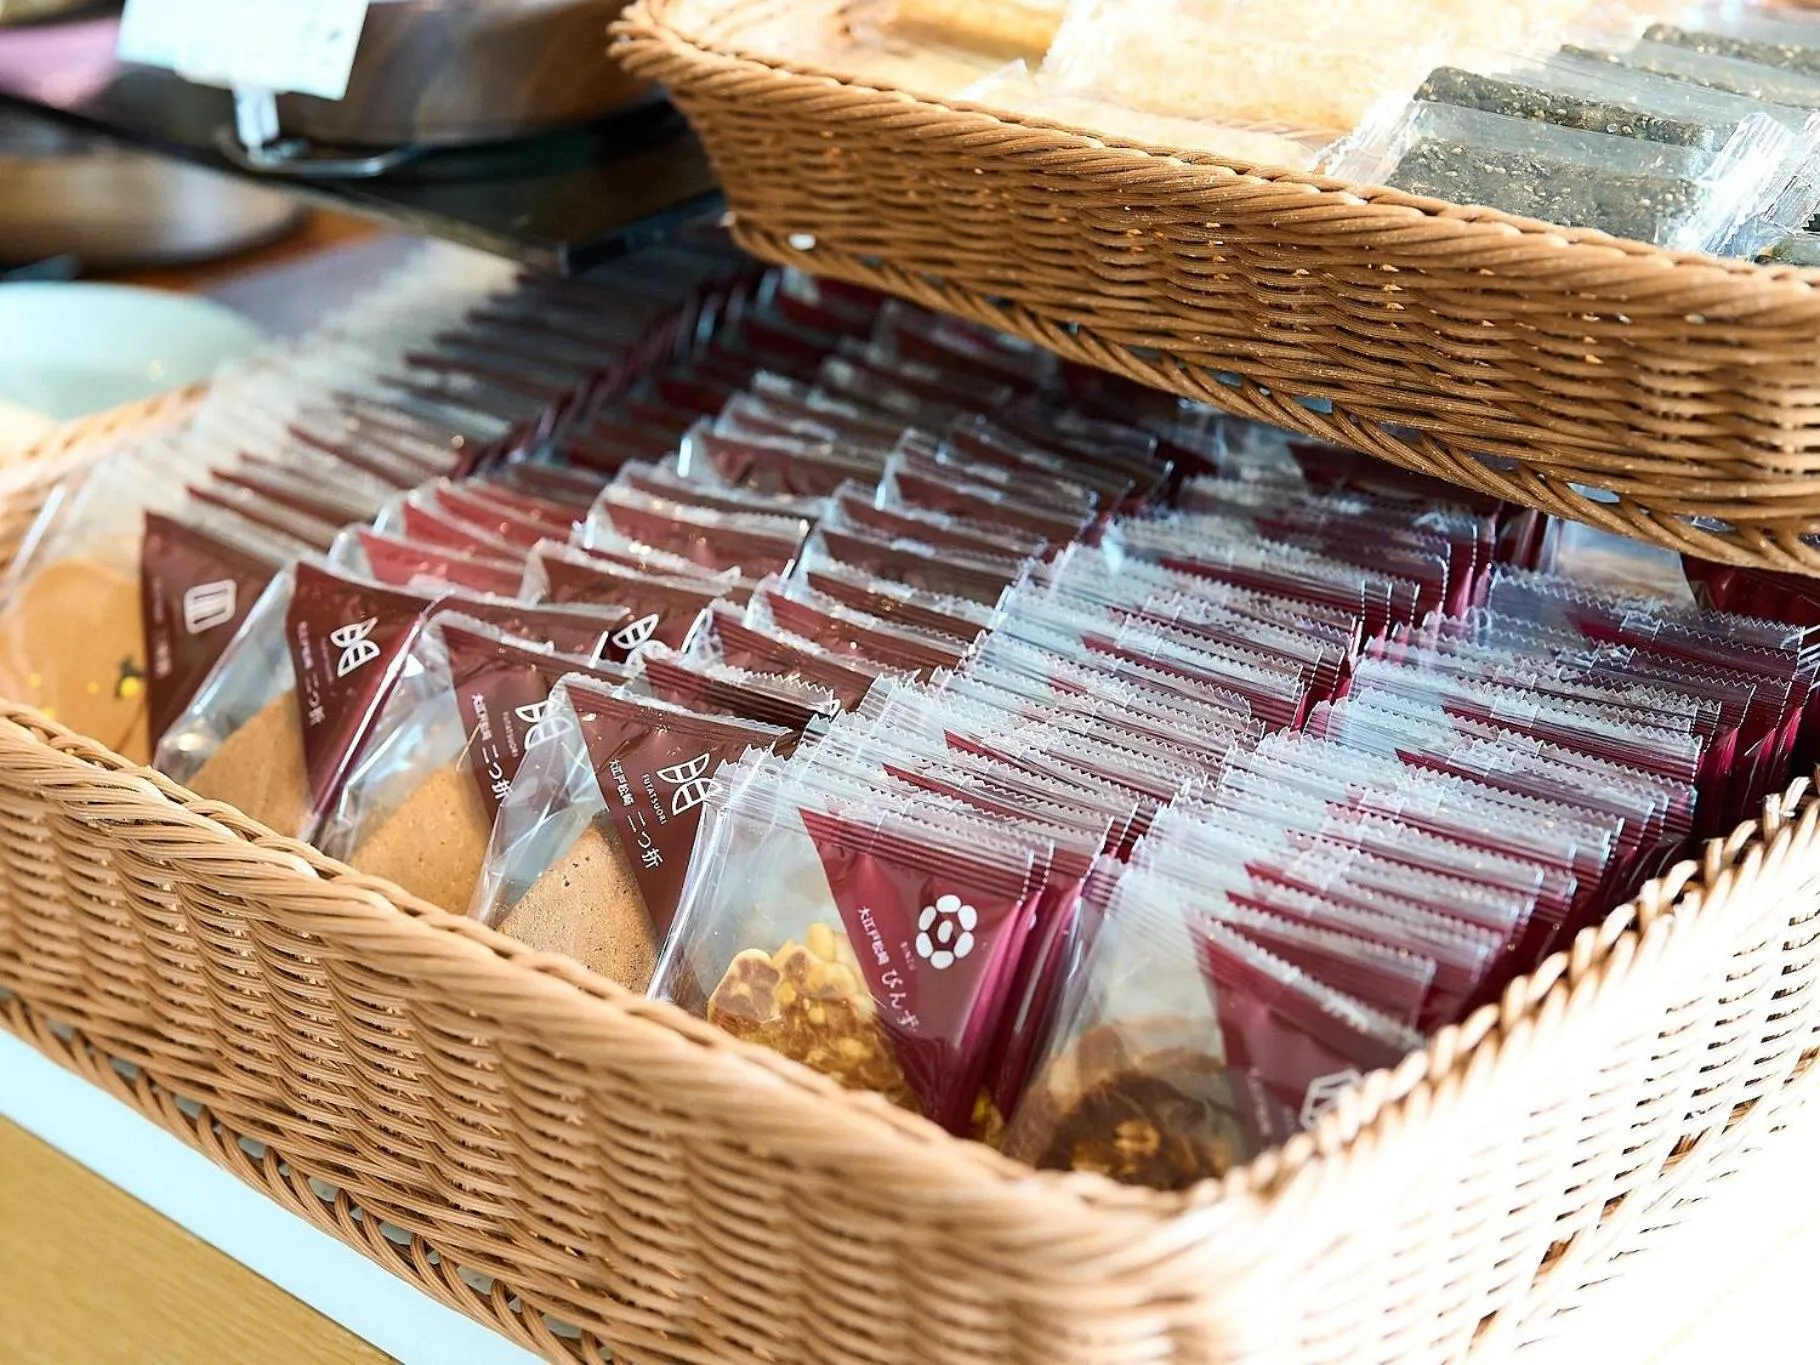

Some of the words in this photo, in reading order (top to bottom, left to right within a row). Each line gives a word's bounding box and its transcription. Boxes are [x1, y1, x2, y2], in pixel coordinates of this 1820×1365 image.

[642, 773, 668, 825] FUTATSUORI
[627, 811, 663, 869] 二つ折
